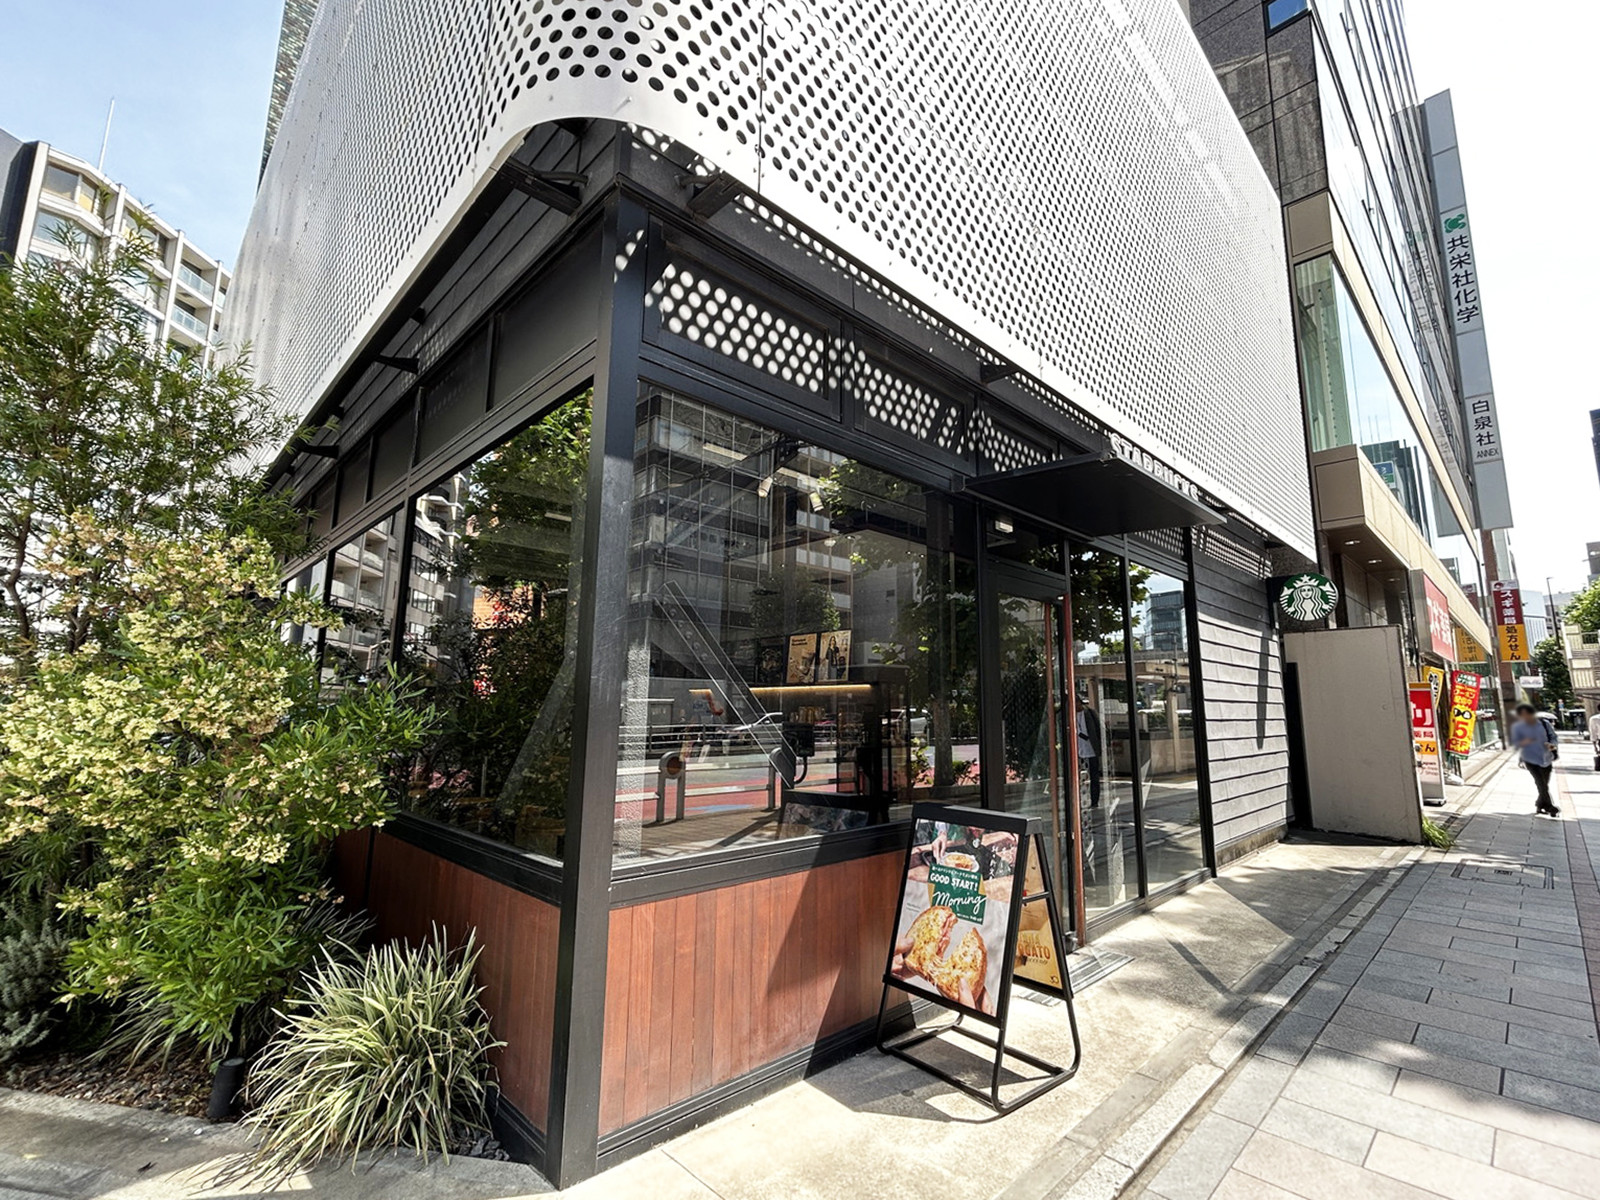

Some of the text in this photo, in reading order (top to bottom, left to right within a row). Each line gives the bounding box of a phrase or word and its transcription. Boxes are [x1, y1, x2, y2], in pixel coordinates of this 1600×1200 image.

[1447, 235, 1479, 323] 共栄社化学
[1472, 400, 1496, 446] 白泉社
[1477, 448, 1499, 458] ANNEX
[1500, 590, 1517, 624] スギ薬局
[1505, 626, 1521, 660] 処方せん
[930, 872, 950, 885] GOOD
[951, 877, 979, 892] START!
[932, 891, 987, 915] Morning
